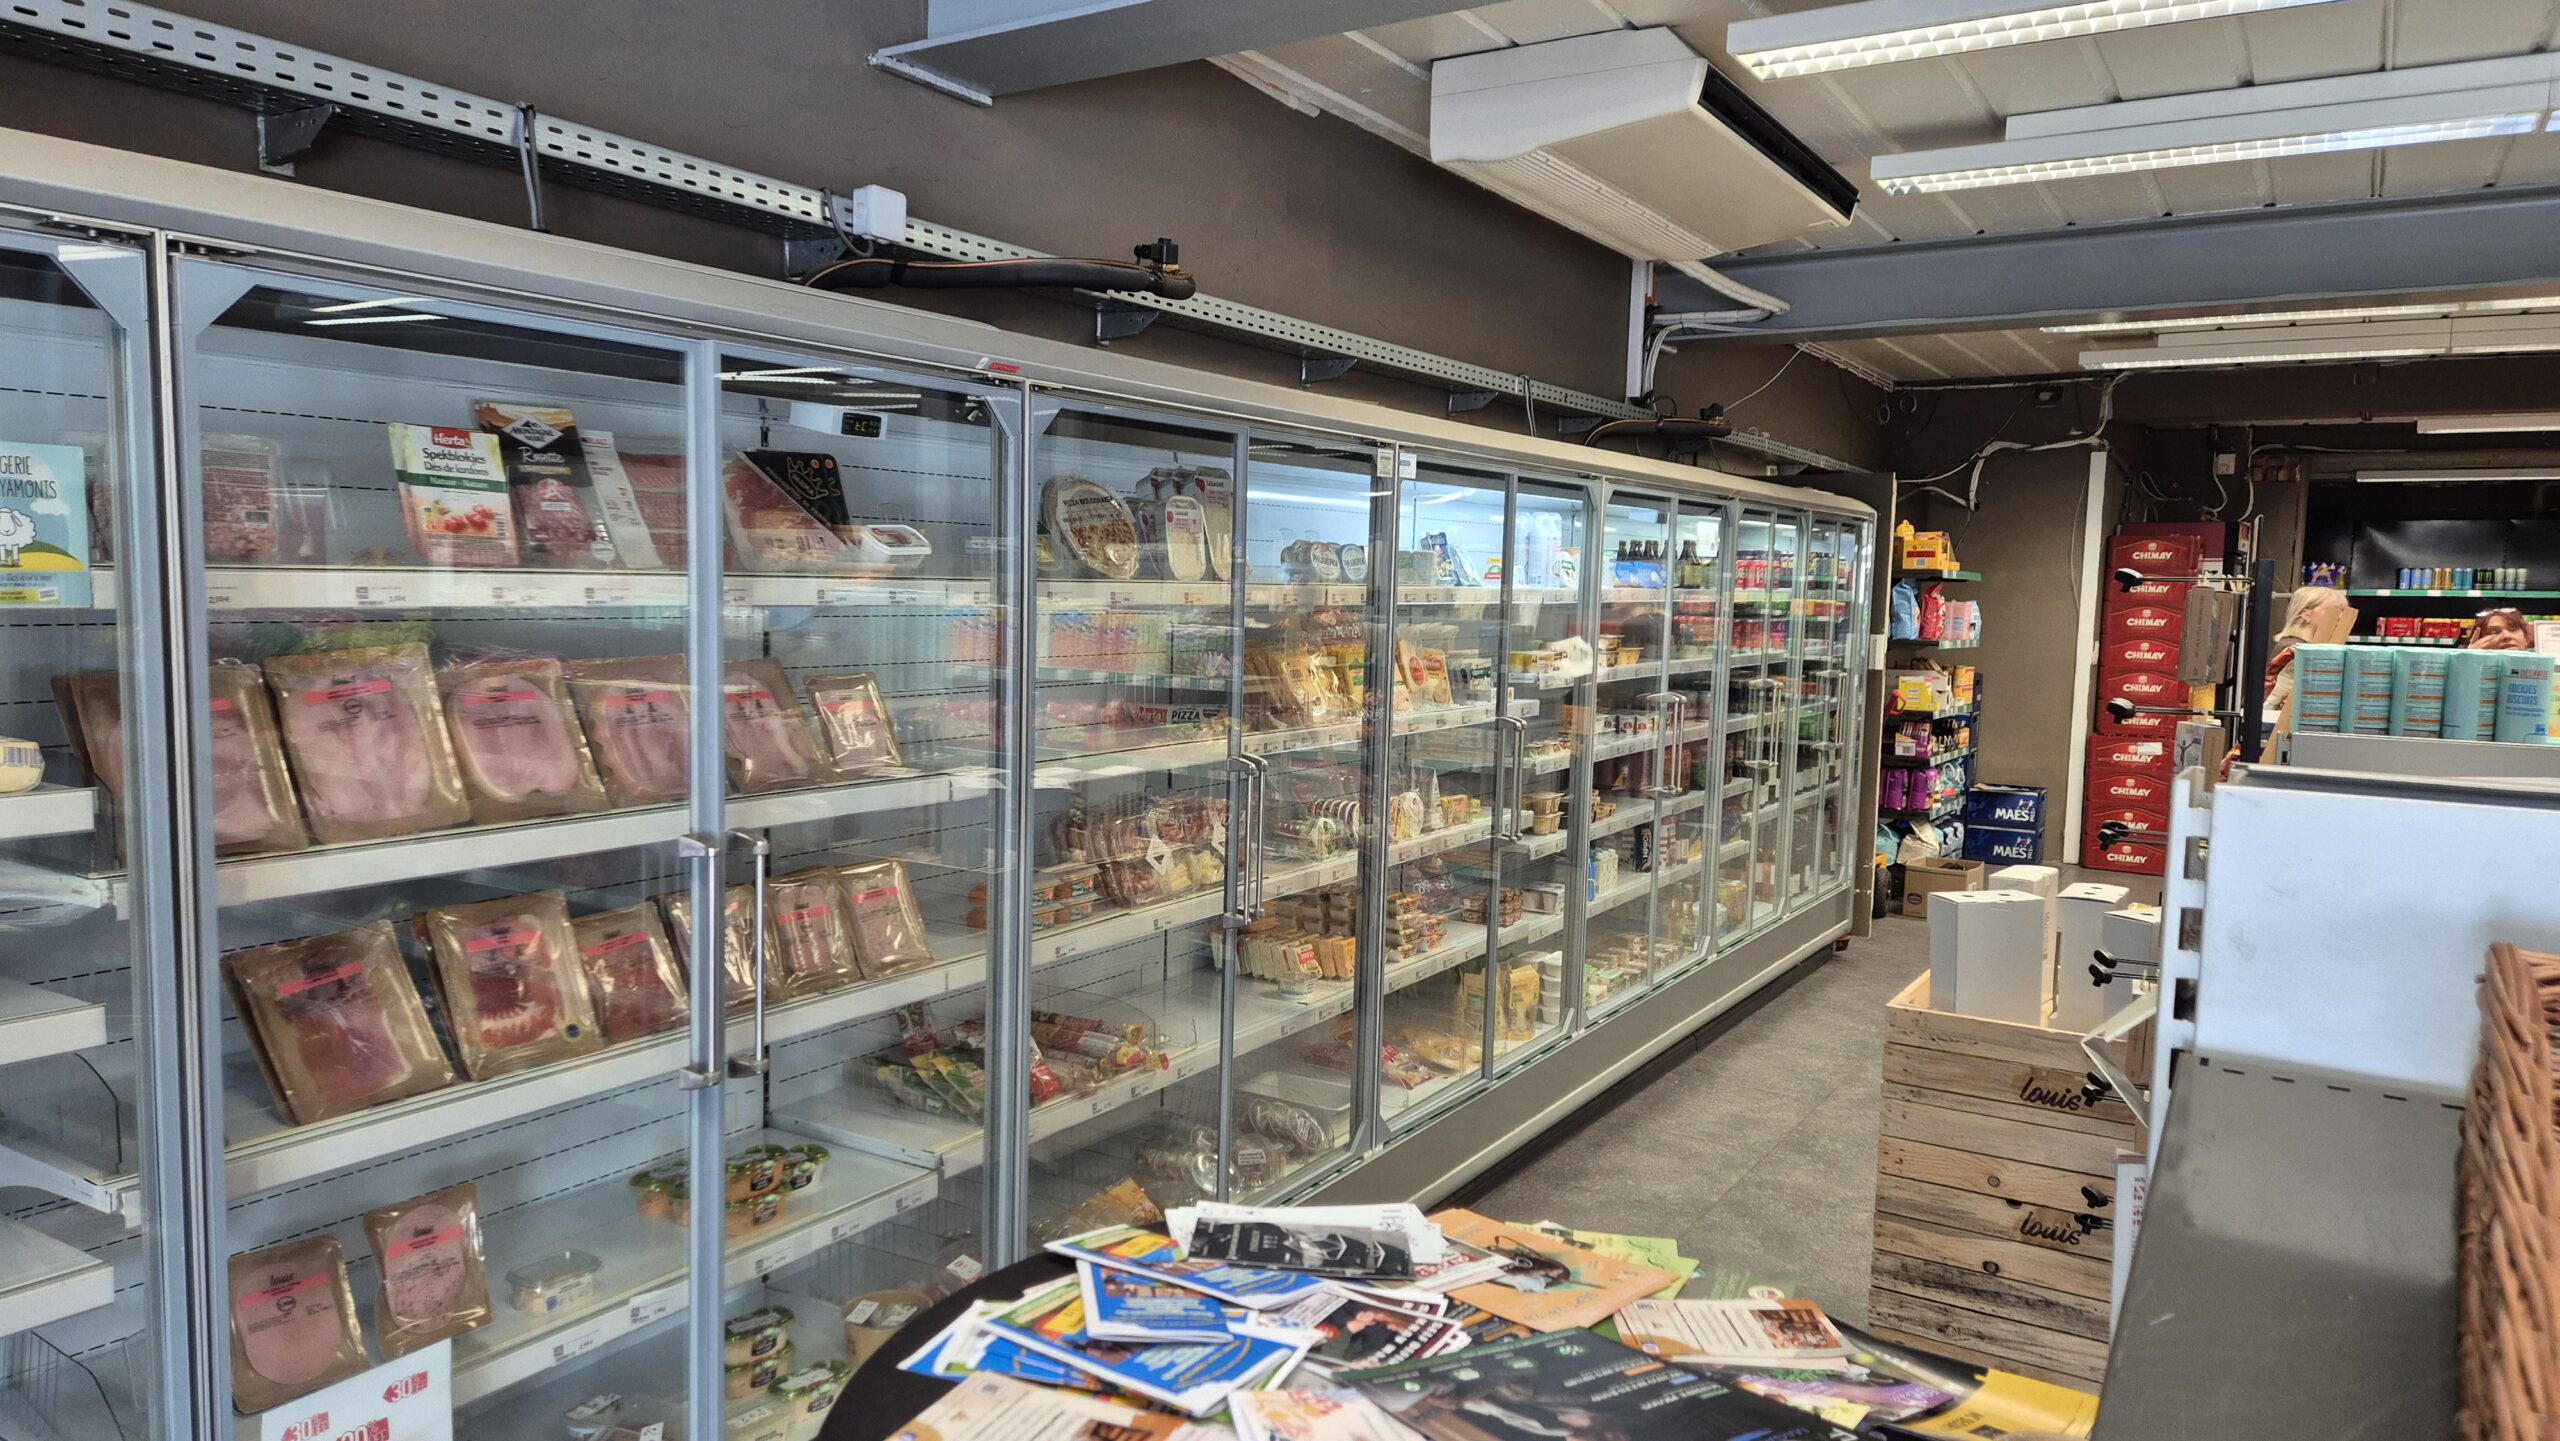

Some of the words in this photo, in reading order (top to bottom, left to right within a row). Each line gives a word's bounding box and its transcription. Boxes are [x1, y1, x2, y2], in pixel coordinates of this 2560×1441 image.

[433, 432, 465, 446] Herta
[443, 463, 455, 473] de
[2132, 551, 2173, 560] CHIMAY
[2129, 585, 2170, 593] CHIMAY
[2126, 618, 2168, 627] CHIMAY
[2124, 650, 2165, 660] CHIMAY
[2122, 683, 2163, 693] CHIMAY
[1171, 711, 1200, 720] PIZZA
[2121, 718, 2161, 726] CHIMAY
[2112, 752, 2153, 763] CHIMAY
[2110, 786, 2152, 797] CHIMAY
[1994, 807, 2029, 821] MAES
[1992, 845, 2027, 859] MAES
[2106, 853, 2148, 864] CHIMAY
[2020, 1076, 2083, 1111] louis
[2020, 1211, 2083, 1245] louis
